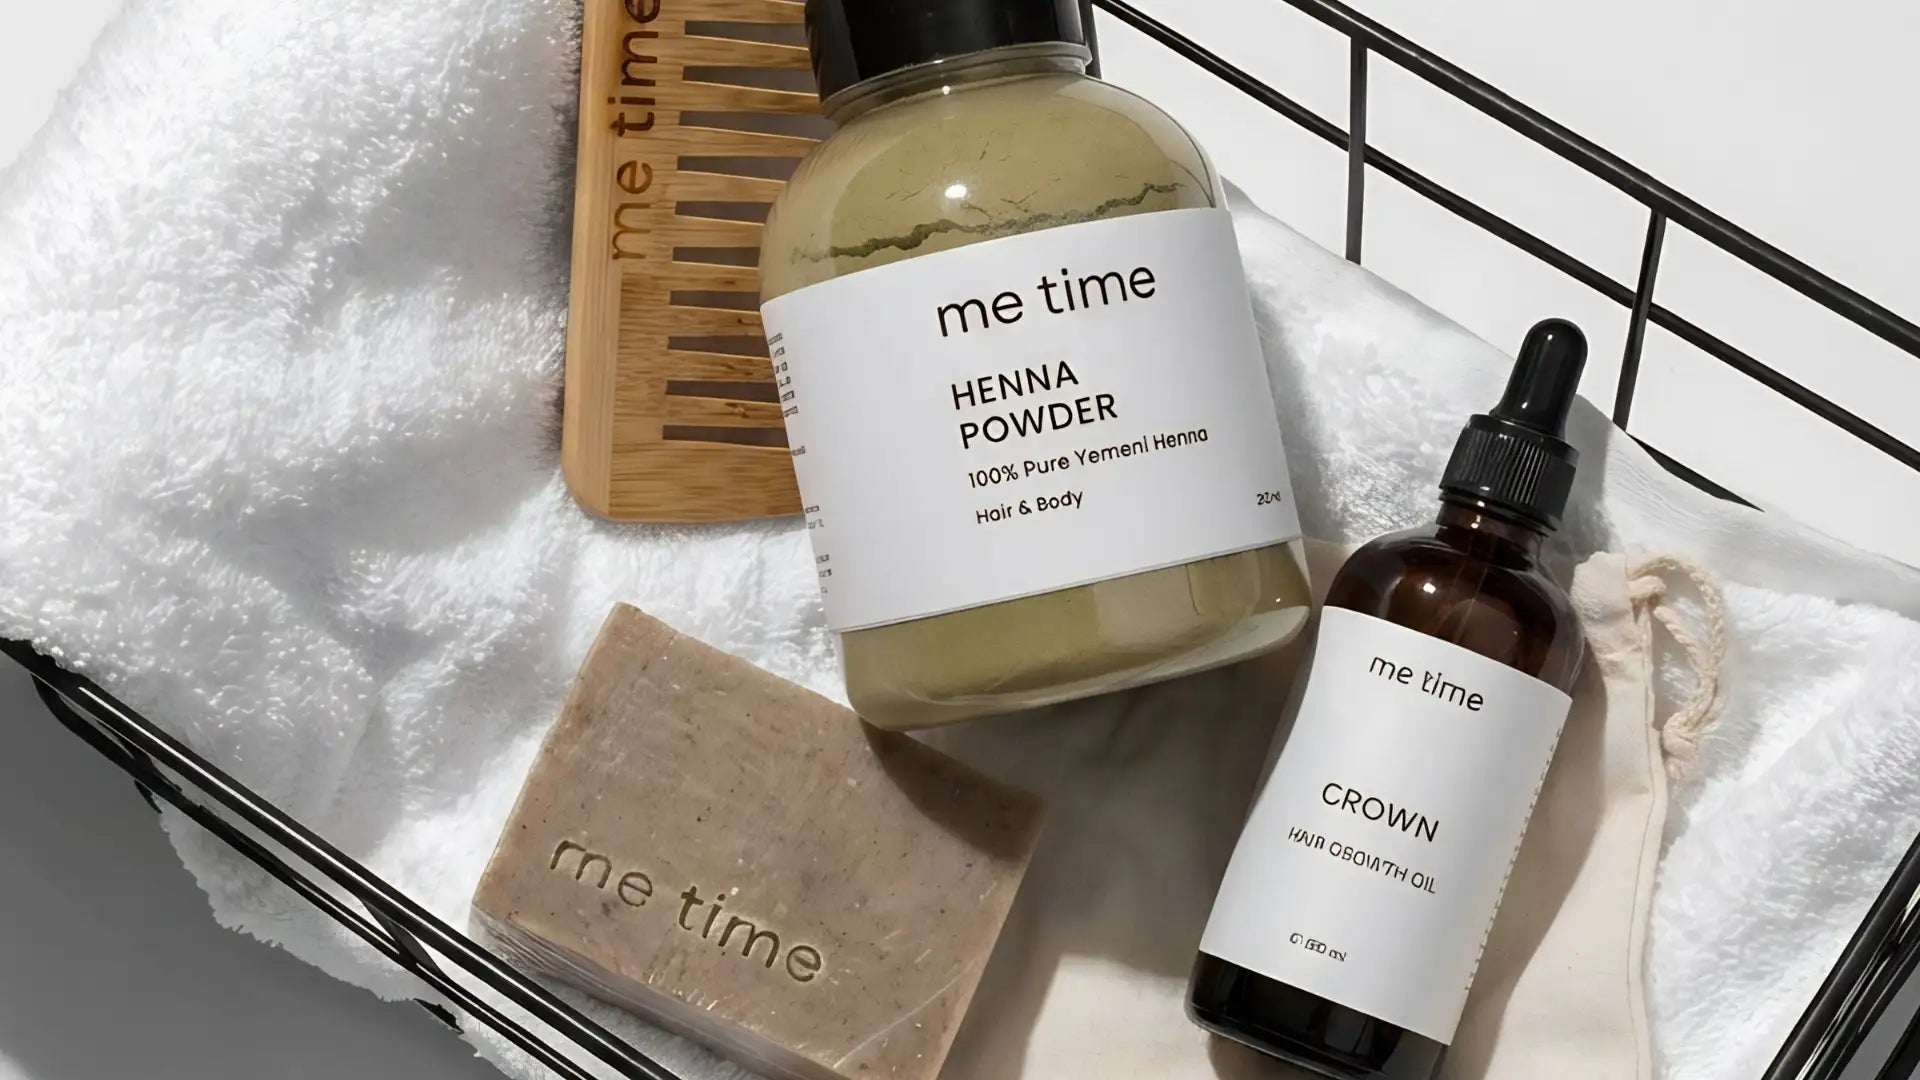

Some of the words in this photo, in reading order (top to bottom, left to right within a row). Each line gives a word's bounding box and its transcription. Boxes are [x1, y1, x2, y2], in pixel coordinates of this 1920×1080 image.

[607, 0, 661, 137] time
[612, 160, 653, 260] me
[937, 290, 1023, 337] me
[1037, 266, 1156, 315] time
[951, 360, 1079, 411] HENNA
[959, 392, 1118, 450] POWDER
[968, 463, 1019, 489] 100%
[1023, 456, 1070, 477] Pure
[1153, 428, 1209, 450] Henna
[976, 503, 1012, 525] Hair
[1018, 499, 1033, 516] &
[1036, 490, 1084, 512] Body
[1369, 656, 1414, 685] me
[1321, 782, 1440, 843] CROWN
[550, 840, 653, 907] me
[678, 885, 823, 983] time
[1410, 872, 1436, 894] OIL
